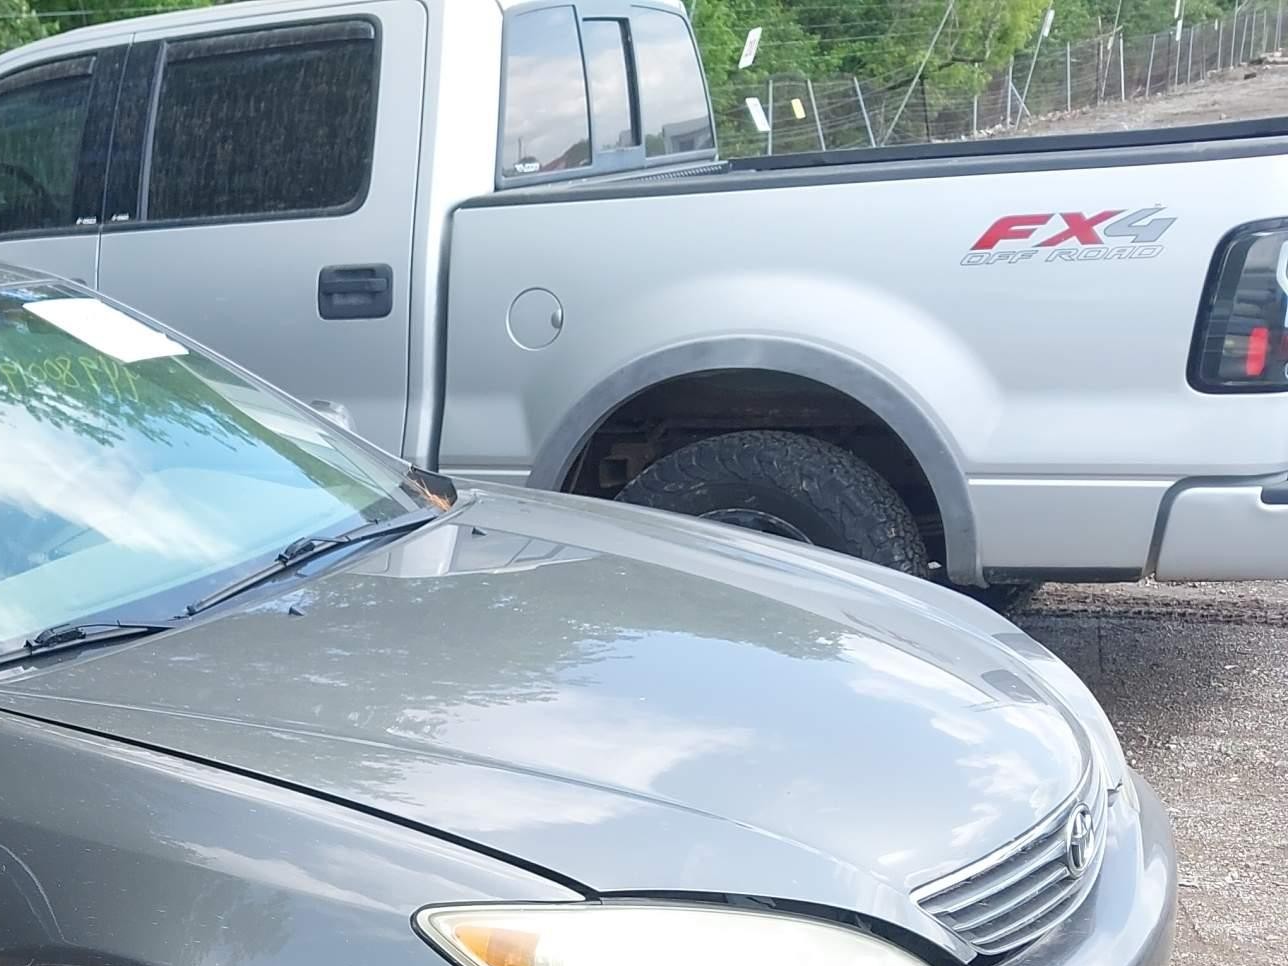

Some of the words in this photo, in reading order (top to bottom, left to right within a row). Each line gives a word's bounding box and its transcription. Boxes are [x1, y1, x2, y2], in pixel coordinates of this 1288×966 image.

[970, 207, 1177, 250] FX4
[960, 249, 1039, 266] OFF
[1044, 245, 1165, 263] ROAD
